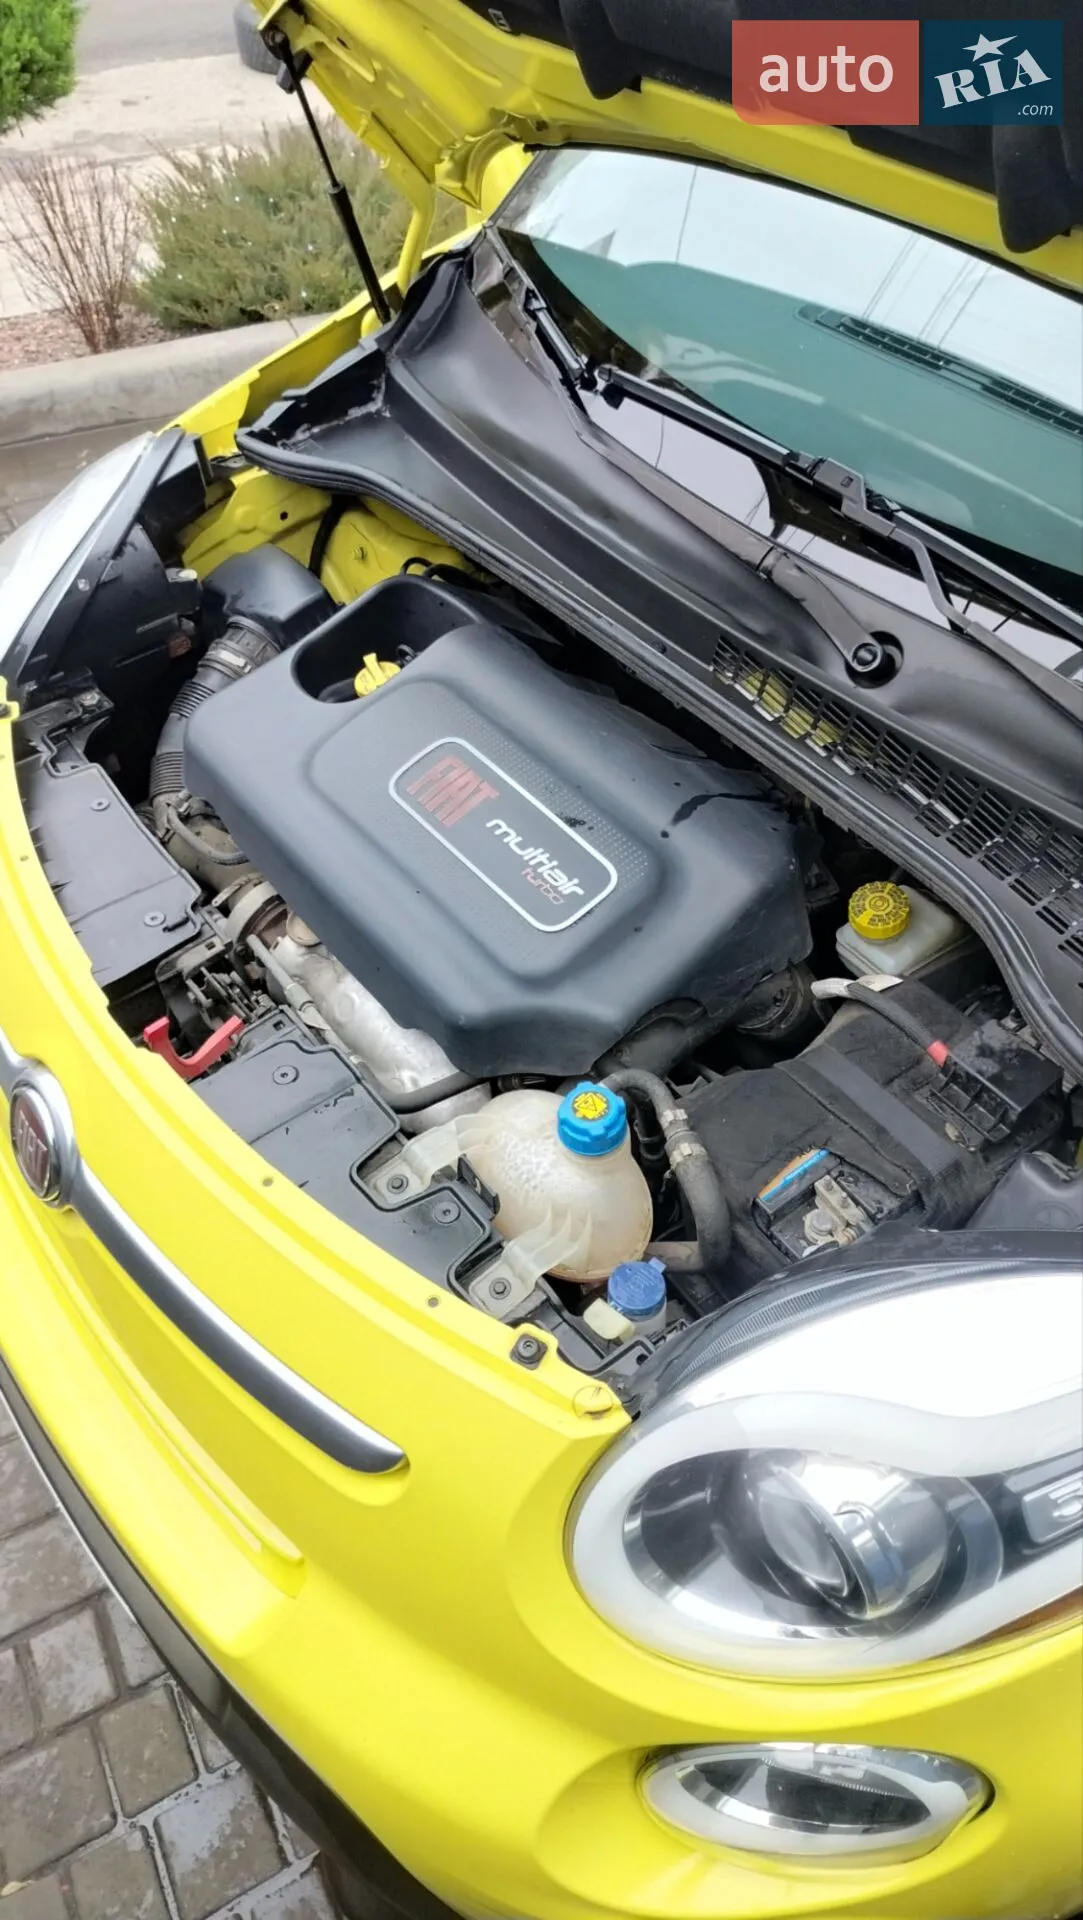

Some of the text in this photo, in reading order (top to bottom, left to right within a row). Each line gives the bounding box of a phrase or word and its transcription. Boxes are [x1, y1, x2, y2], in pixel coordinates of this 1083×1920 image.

[406, 755, 500, 829] FIAT
[485, 818, 585, 896] multiair
[521, 867, 565, 906] turbo
[12, 1109, 48, 1180] FIAT
